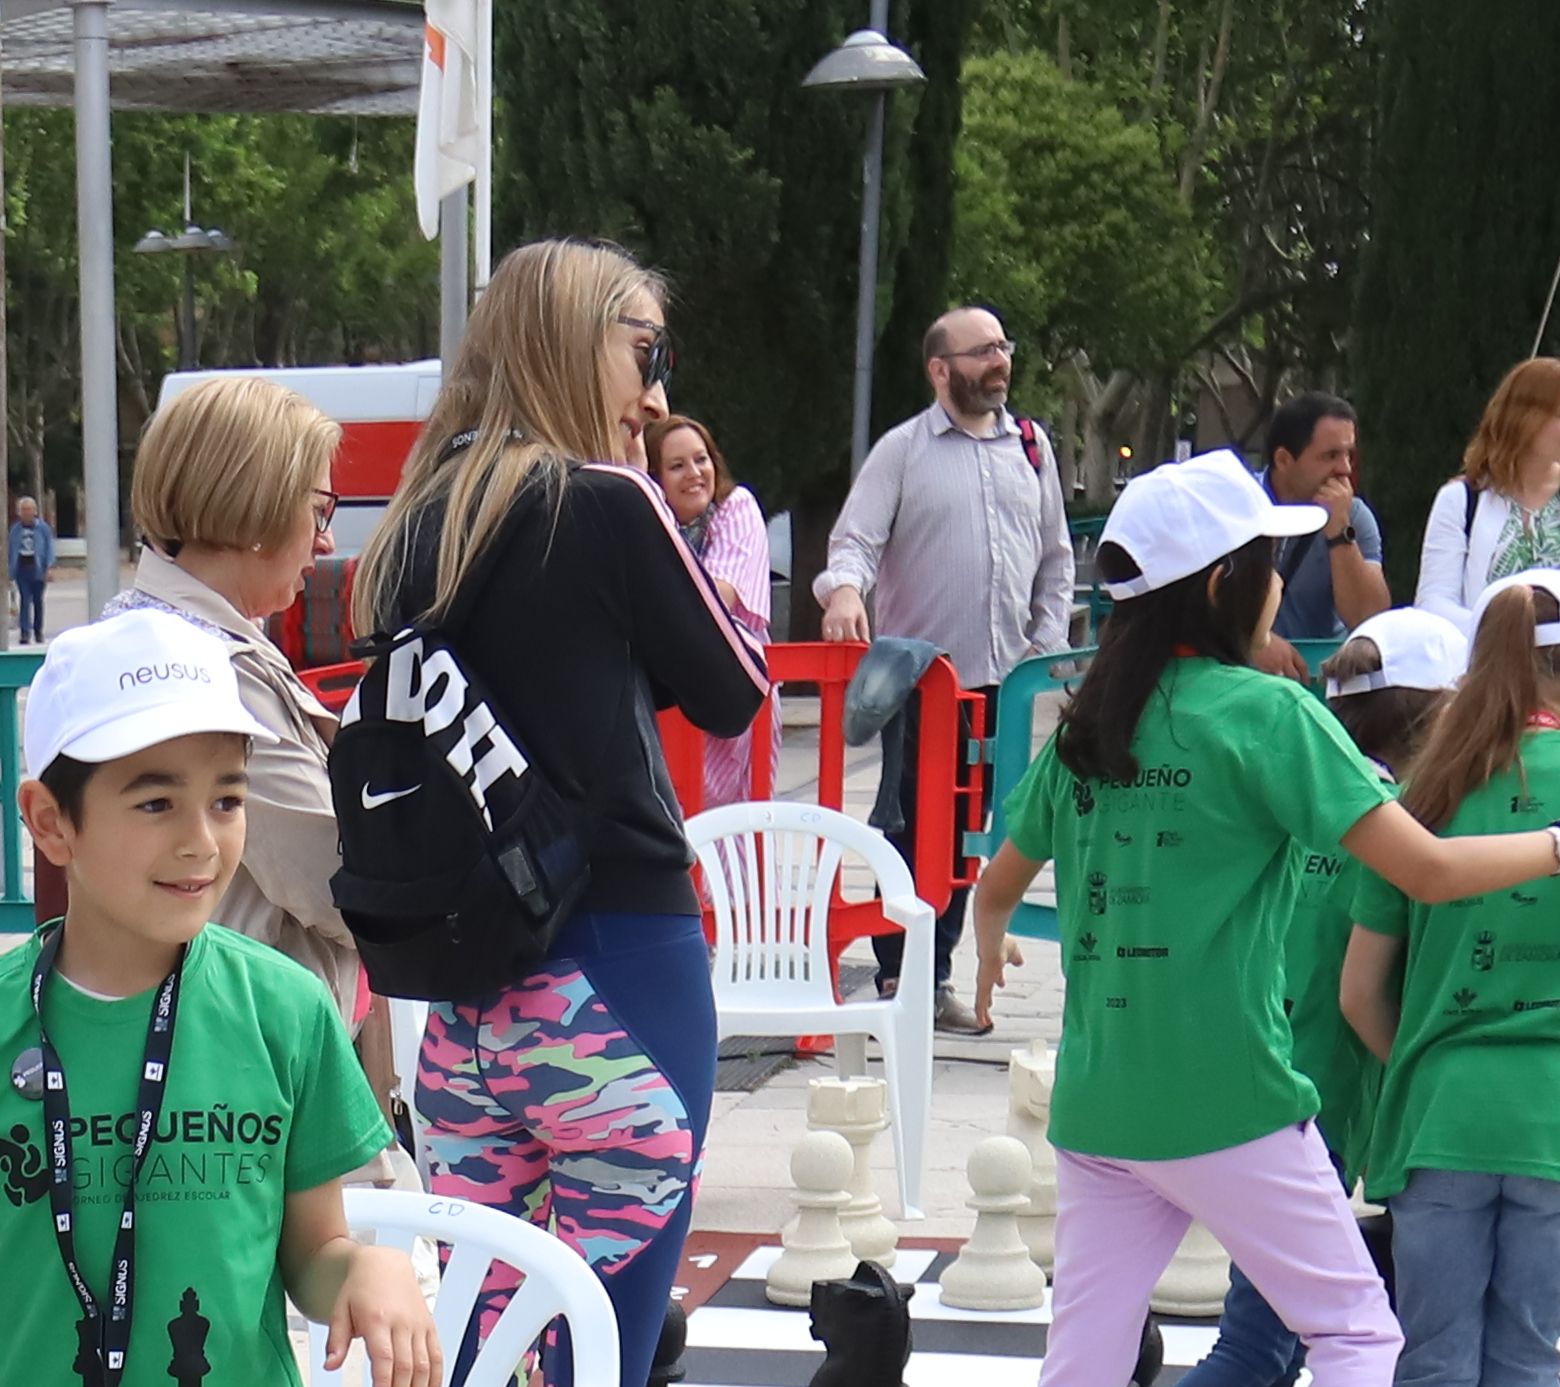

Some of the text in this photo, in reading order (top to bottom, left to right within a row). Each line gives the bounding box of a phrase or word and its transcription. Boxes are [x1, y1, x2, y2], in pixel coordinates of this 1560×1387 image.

[119, 662, 211, 691] neusus
[386, 636, 469, 737] DO
[159, 974, 176, 1017] SIGNUS
[54, 1120, 66, 1168] SIGNUS
[135, 1110, 153, 1157] SIGNUS
[74, 1193, 111, 1206] ORNEO
[184, 1190, 231, 1201] ESCOLAR
[429, 1202, 465, 1217] CD
[688, 1253, 719, 1268] 1
[115, 1260, 128, 1306] SIGNUS
